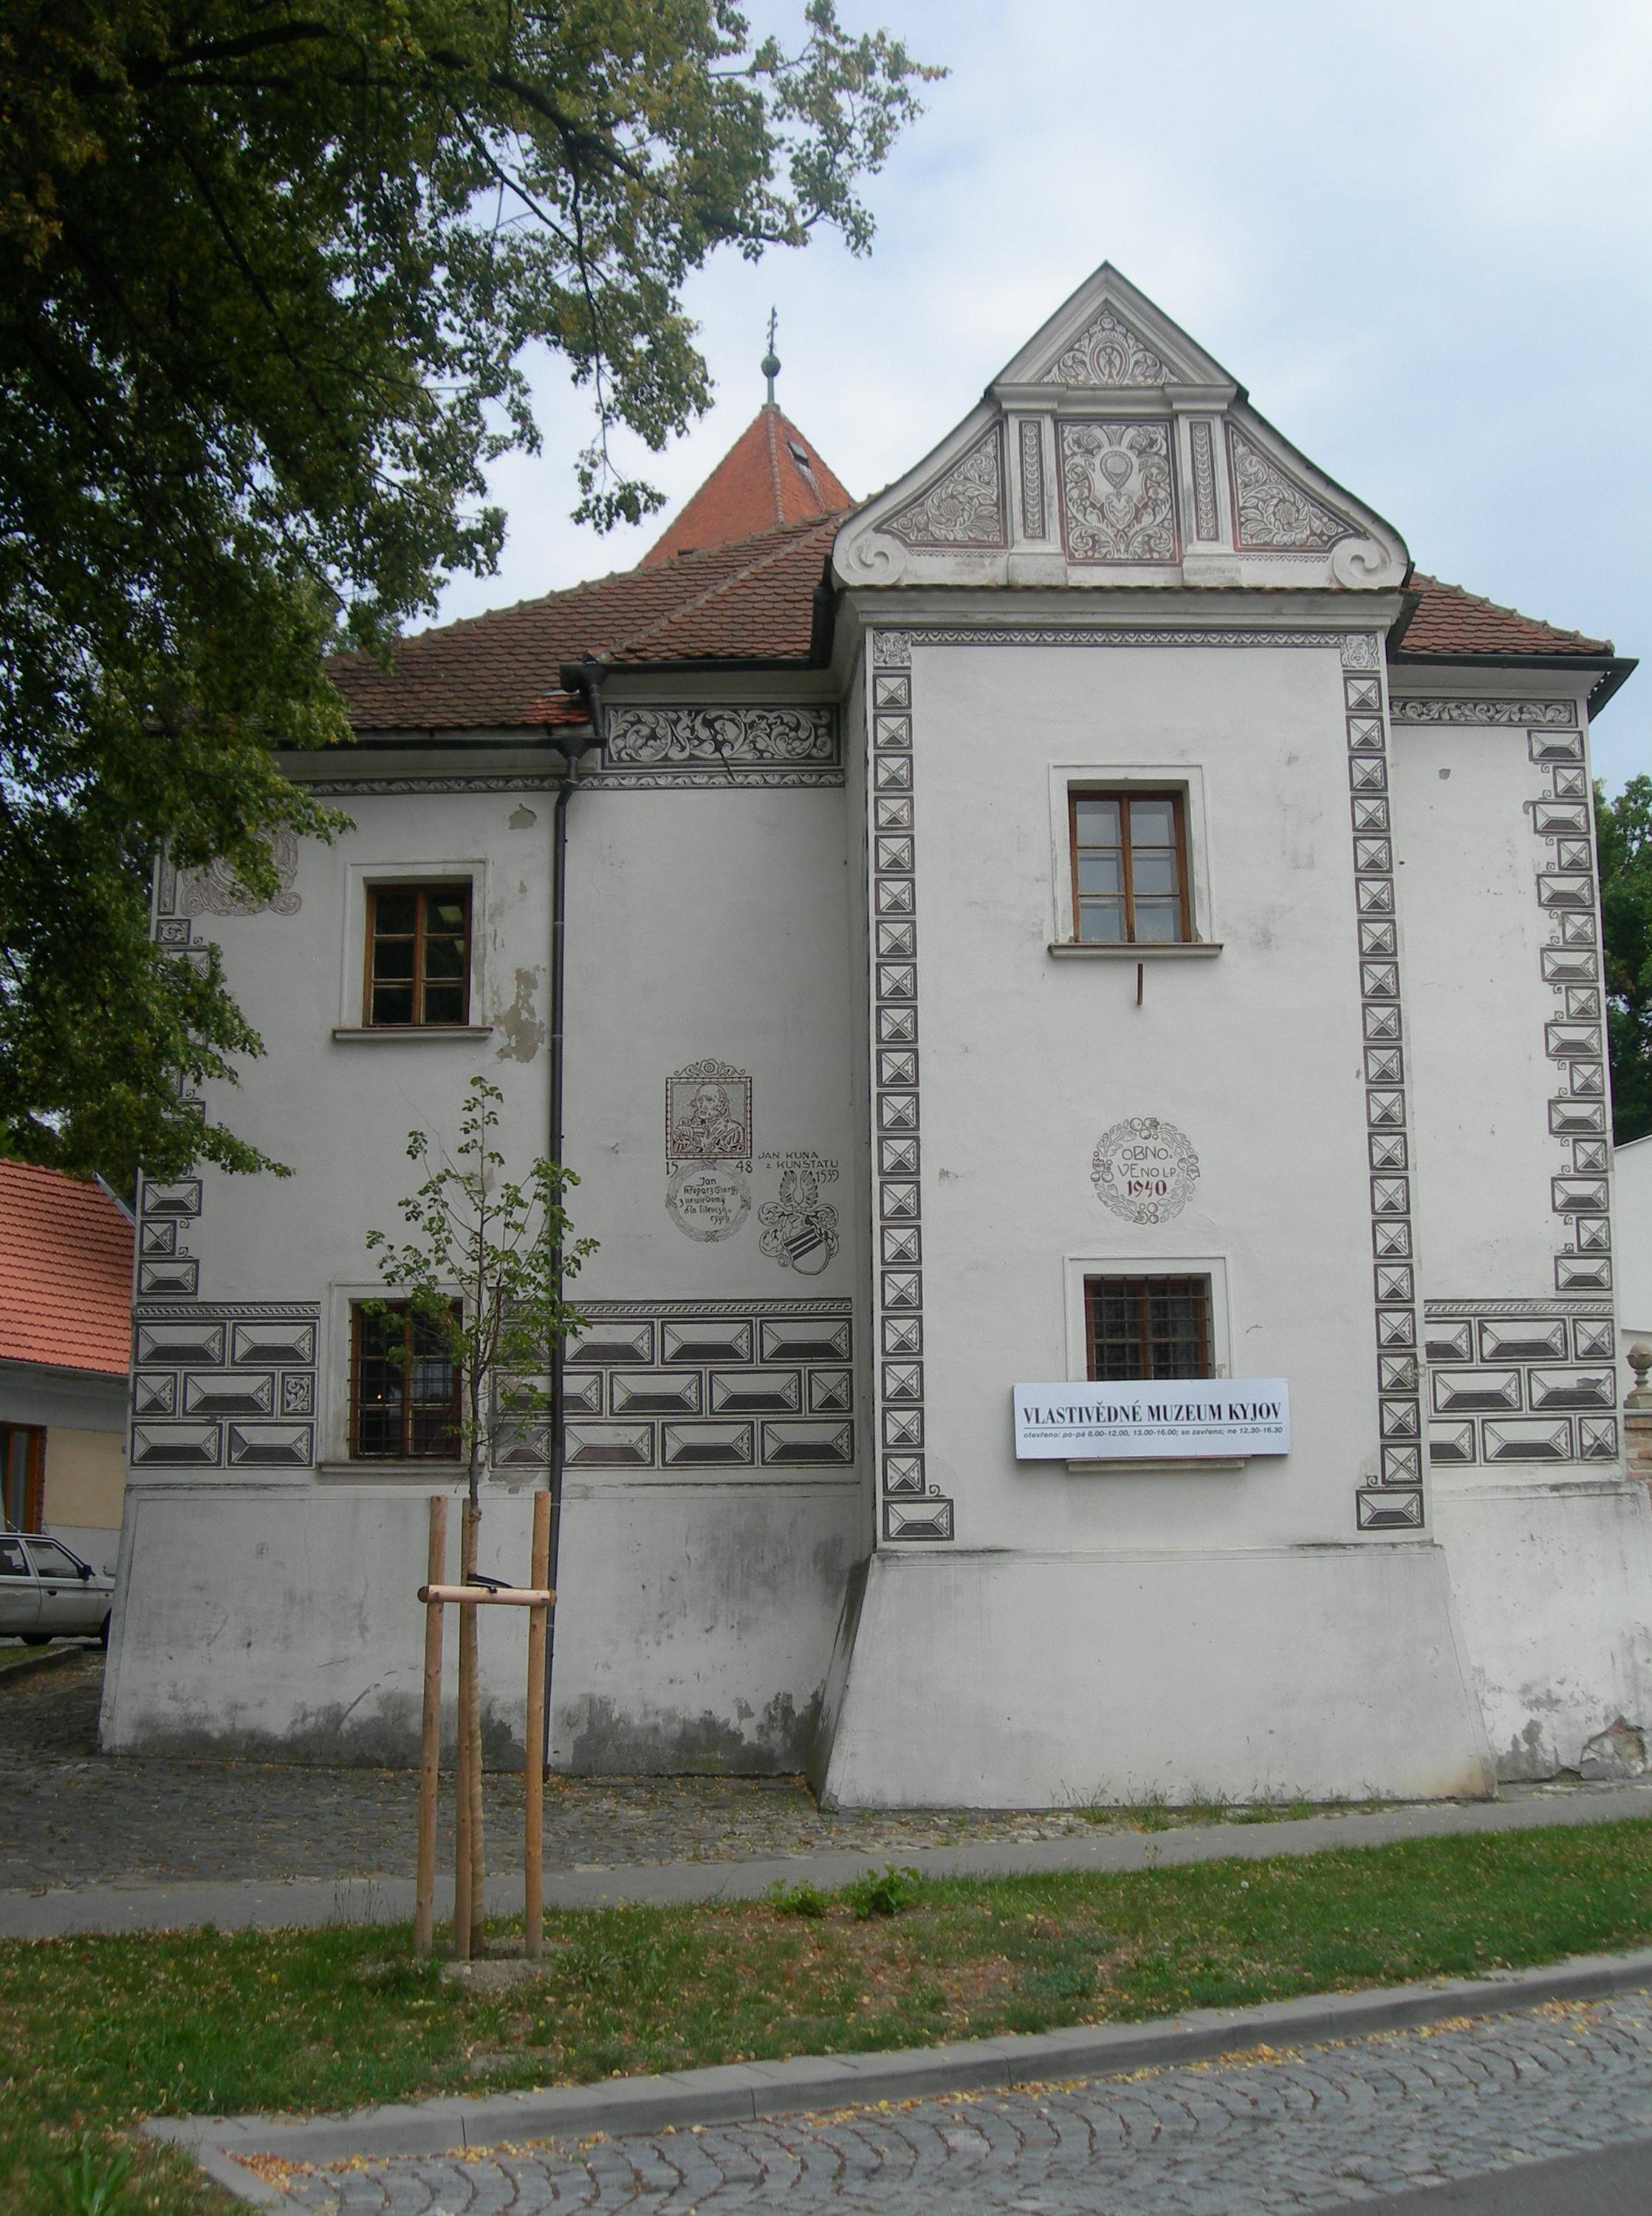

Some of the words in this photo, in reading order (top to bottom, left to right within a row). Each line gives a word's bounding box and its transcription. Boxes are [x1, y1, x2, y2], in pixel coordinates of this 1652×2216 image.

[758, 1152, 780, 1160] JAN
[786, 1151, 819, 1160] KUNA
[665, 1160, 679, 1179] 15
[736, 1160, 753, 1174] 48
[776, 1160, 839, 1169] KUNSTATU
[1117, 1163, 1159, 1178] VENO
[696, 1177, 716, 1187] Jan
[815, 1169, 840, 1185] 1539
[1127, 1179, 1167, 1198] 1940
[1023, 1400, 1142, 1424] VLASTIVĚDNÉ
[1148, 1403, 1223, 1422] MUZEUM
[1228, 1402, 1282, 1421] KYJOV
[1024, 1429, 1060, 1438] otevřeno:
[1063, 1429, 1086, 1439] po-pá
[1087, 1429, 1130, 1437] 8.00-12.00,
[1133, 1429, 1179, 1437] 13.00-16.00;
[1192, 1426, 1225, 1435] zavřeno;
